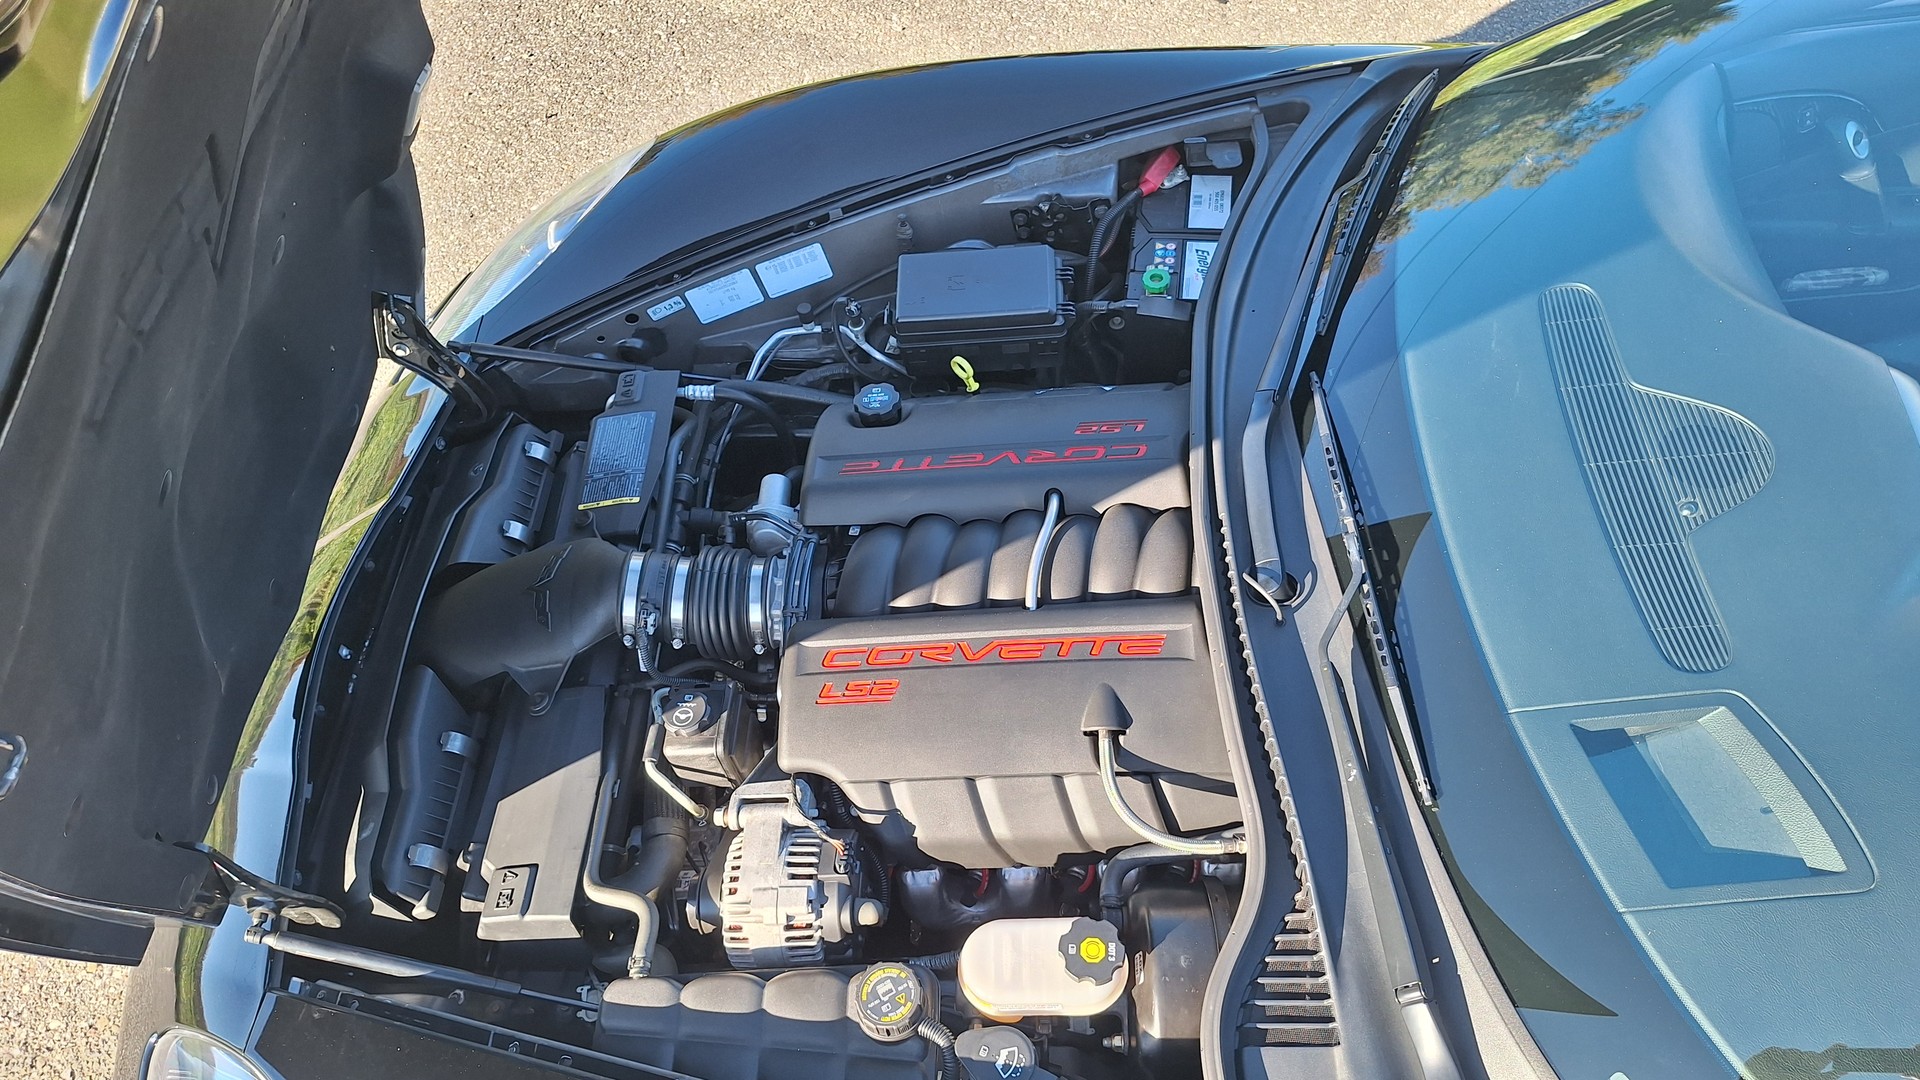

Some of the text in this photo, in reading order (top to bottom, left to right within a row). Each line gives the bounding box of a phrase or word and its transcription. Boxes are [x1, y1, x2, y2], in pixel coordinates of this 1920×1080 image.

[1073, 421, 1147, 435] LS2
[838, 443, 1149, 475] CORVETTE
[821, 634, 1167, 667] CORVETTE
[816, 678, 900, 700] LS2
[1108, 942, 1116, 956] DOT
